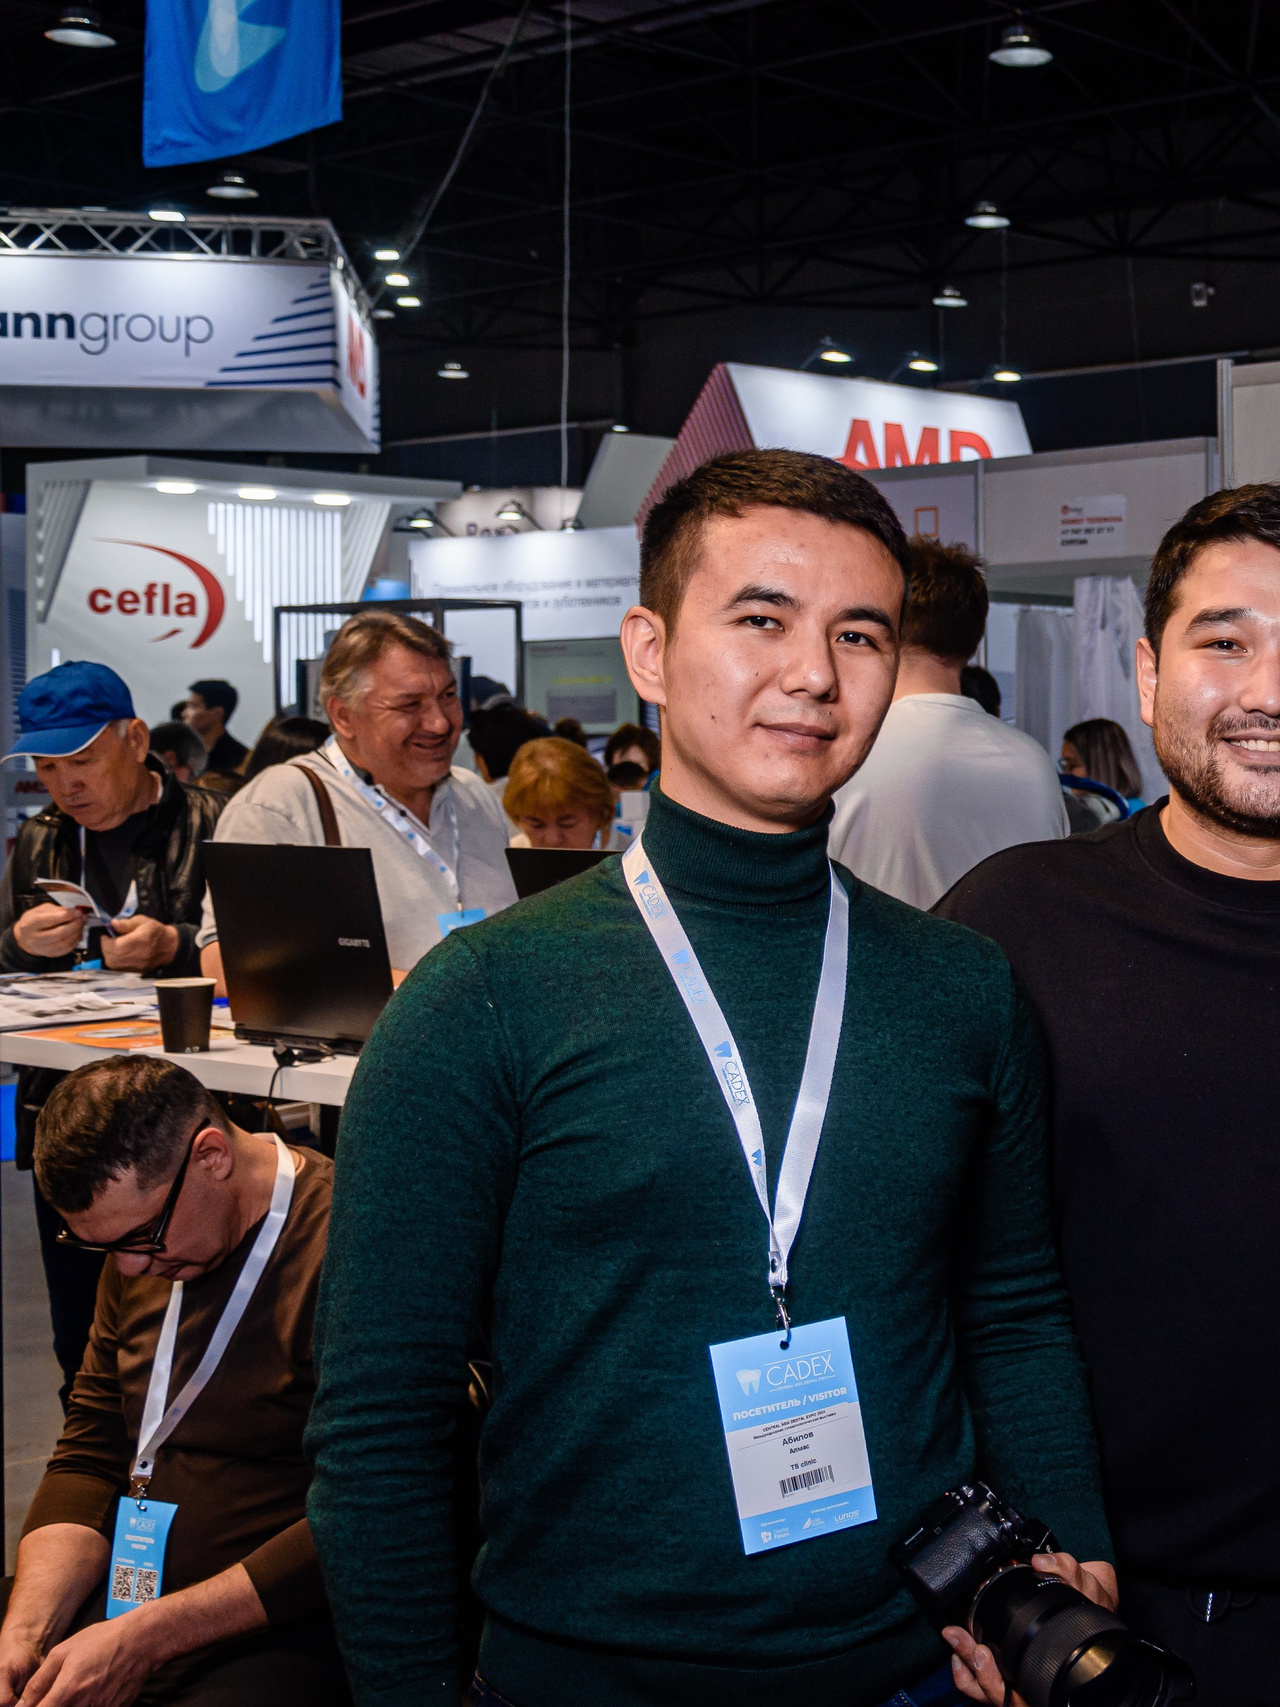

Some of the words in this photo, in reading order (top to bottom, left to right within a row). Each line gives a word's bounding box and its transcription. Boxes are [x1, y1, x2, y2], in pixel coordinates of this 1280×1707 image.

[0, 310, 214, 357] nngroup
[87, 582, 197, 619] cefla
[642, 884, 668, 919] CADEX
[724, 1060, 750, 1107] CADEX
[766, 1353, 835, 1386] CADEX
[733, 1398, 801, 1421] ПОСЕТИТЕЛЬ
[807, 1387, 848, 1403] VISITOR
[782, 1431, 814, 1446] Абилов
[789, 1444, 810, 1454] Алмас
[800, 1458, 817, 1468] clinic
